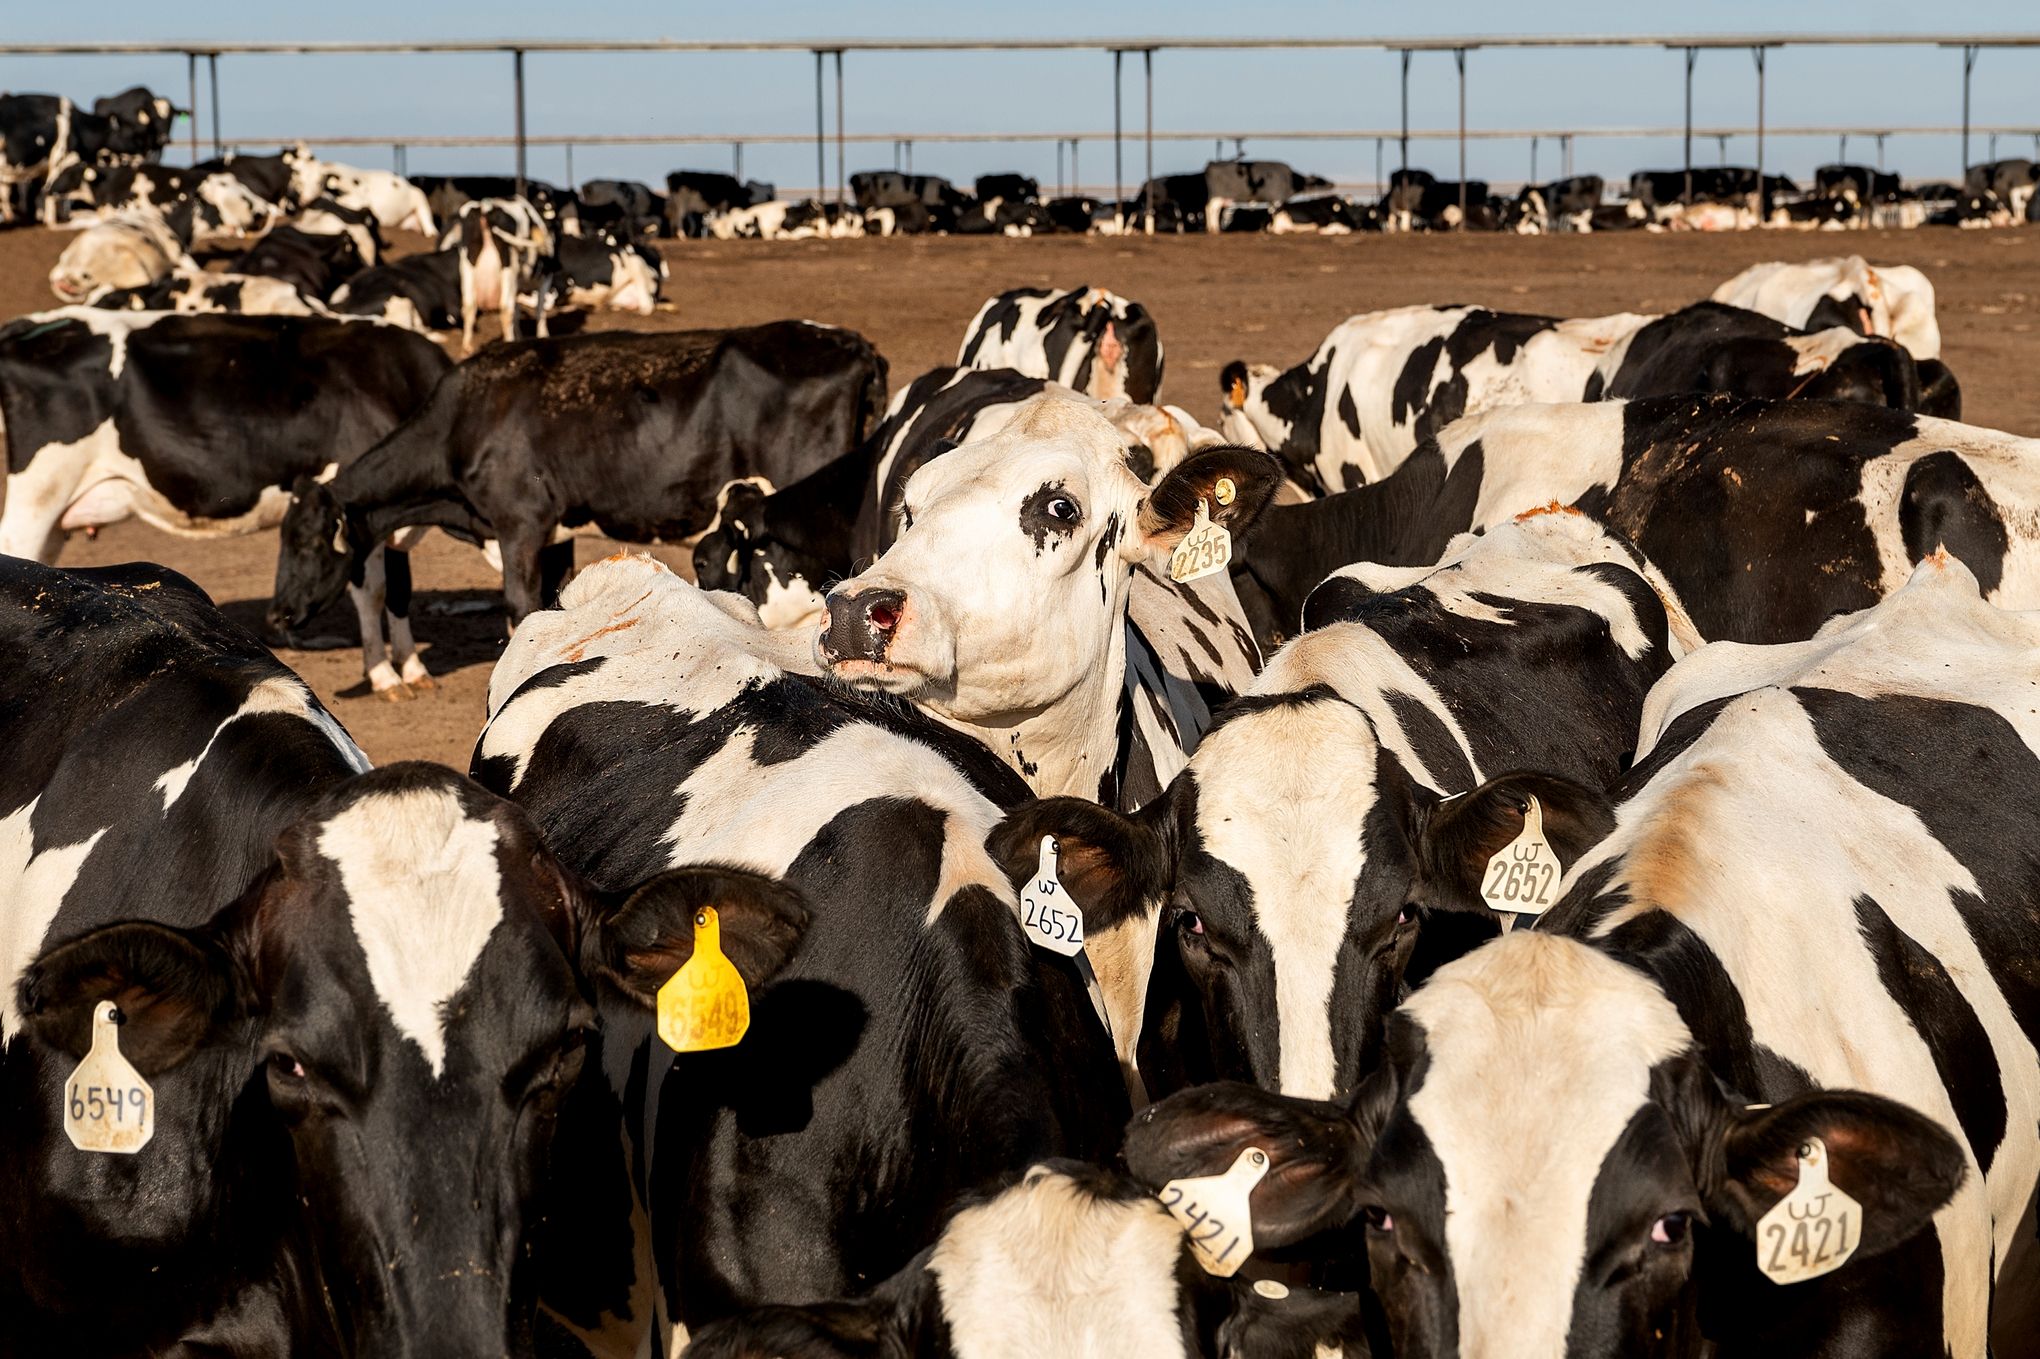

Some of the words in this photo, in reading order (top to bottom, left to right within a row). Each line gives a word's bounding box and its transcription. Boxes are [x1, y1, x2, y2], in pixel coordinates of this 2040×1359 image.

[1173, 534, 1226, 579] 2235
[1485, 860, 1554, 904] 2652
[1025, 899, 1082, 943] 2652
[669, 990, 739, 1043] 6549
[70, 1083, 146, 1127] 6549
[1166, 1187, 1240, 1264] 2421
[1767, 1211, 1848, 1272] 2421
